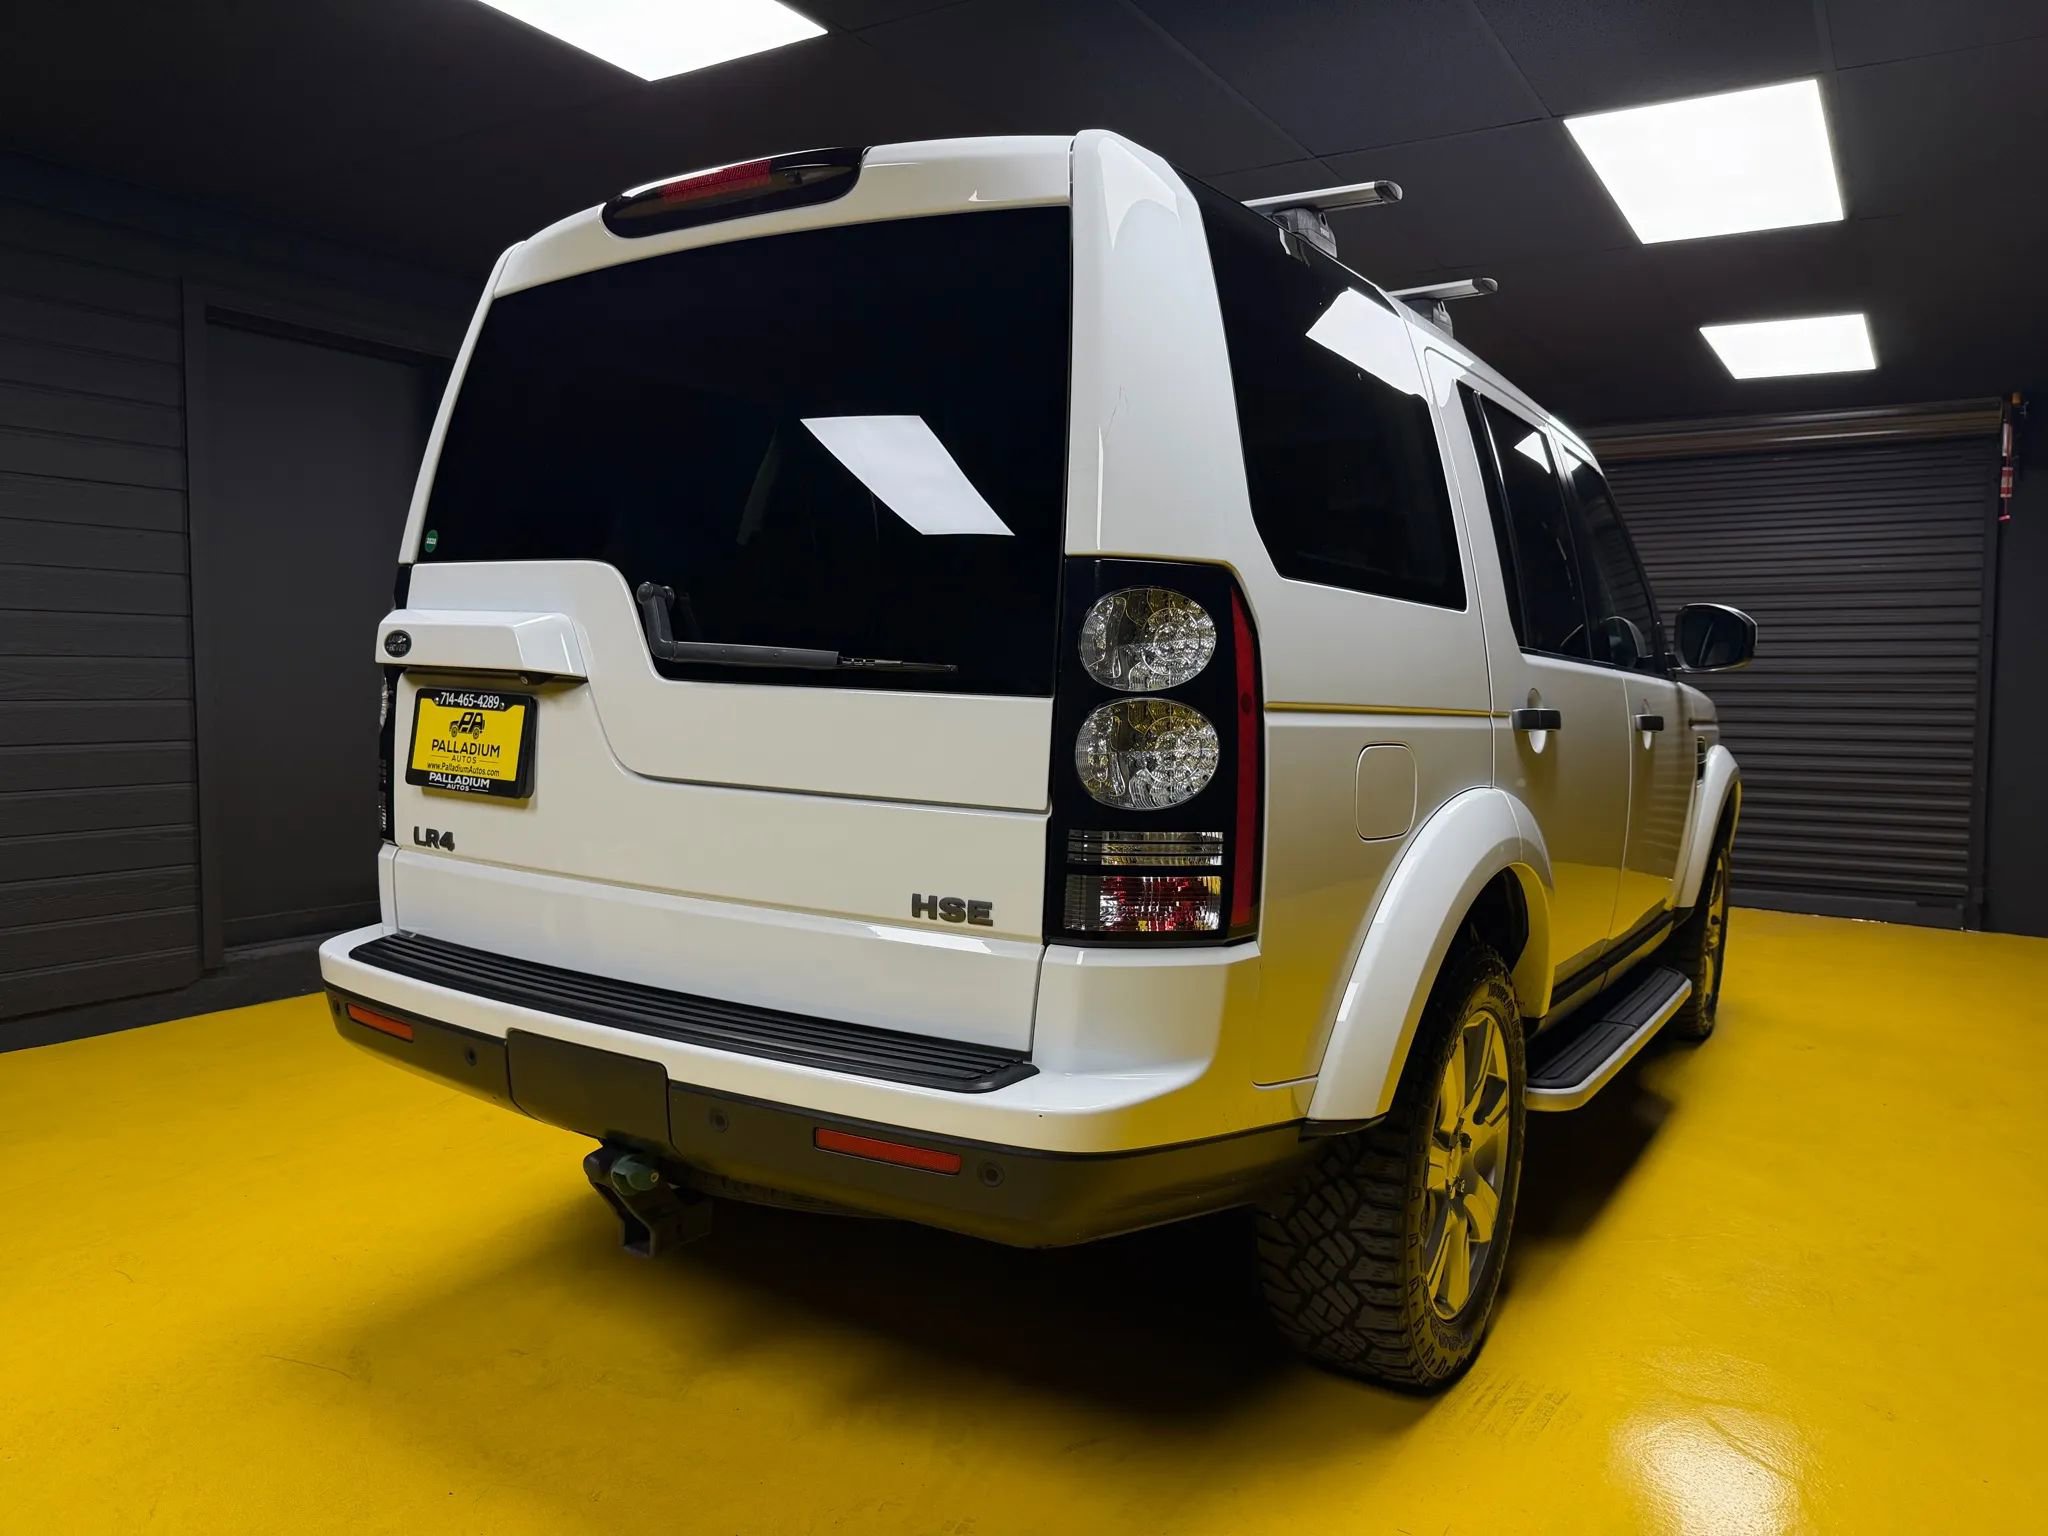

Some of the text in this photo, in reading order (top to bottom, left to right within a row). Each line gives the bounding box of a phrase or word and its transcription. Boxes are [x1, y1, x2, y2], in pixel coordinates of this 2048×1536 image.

[440, 691, 500, 709] 714-465-4289
[431, 739, 500, 758] PALLADIUM
[451, 755, 477, 764] AUTOS
[427, 761, 500, 777] www.PalladiumAutos.com
[428, 771, 490, 789] PALLADIUM
[446, 783, 470, 792] AUTOS
[413, 825, 456, 852] LR4
[911, 892, 994, 927] HSE
